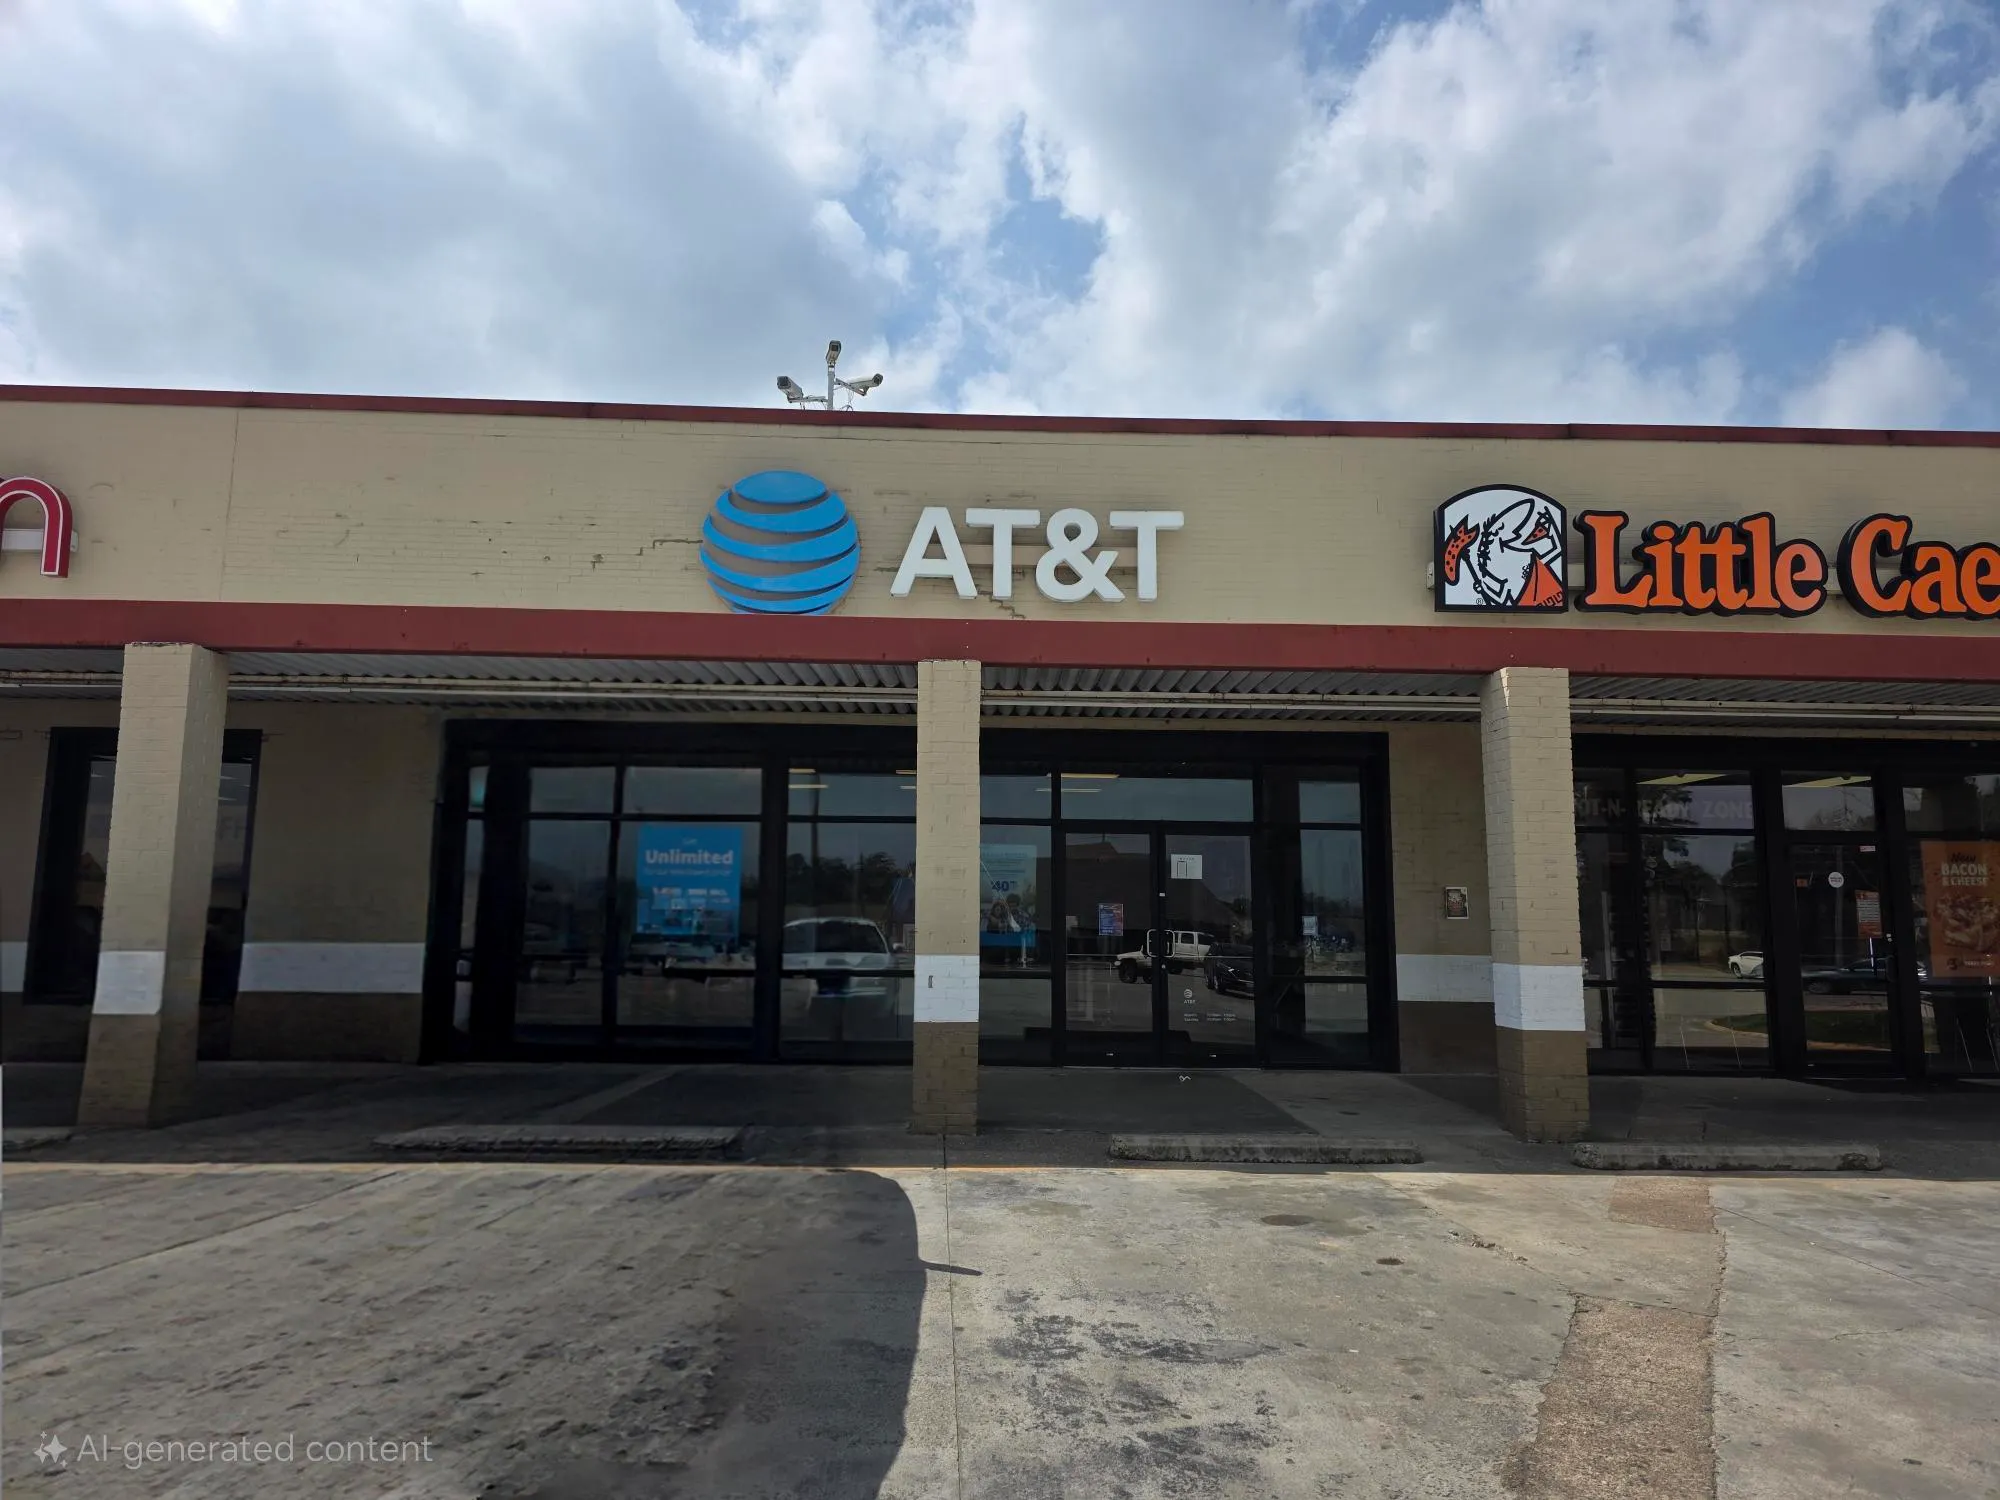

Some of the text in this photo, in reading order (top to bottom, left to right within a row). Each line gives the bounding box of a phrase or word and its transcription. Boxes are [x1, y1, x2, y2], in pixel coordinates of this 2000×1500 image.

[890, 506, 1184, 602] AT&T
[1576, 510, 2000, 618] Little Cae
[645, 849, 734, 865] Unlimited
[1941, 863, 1988, 876] BACON
